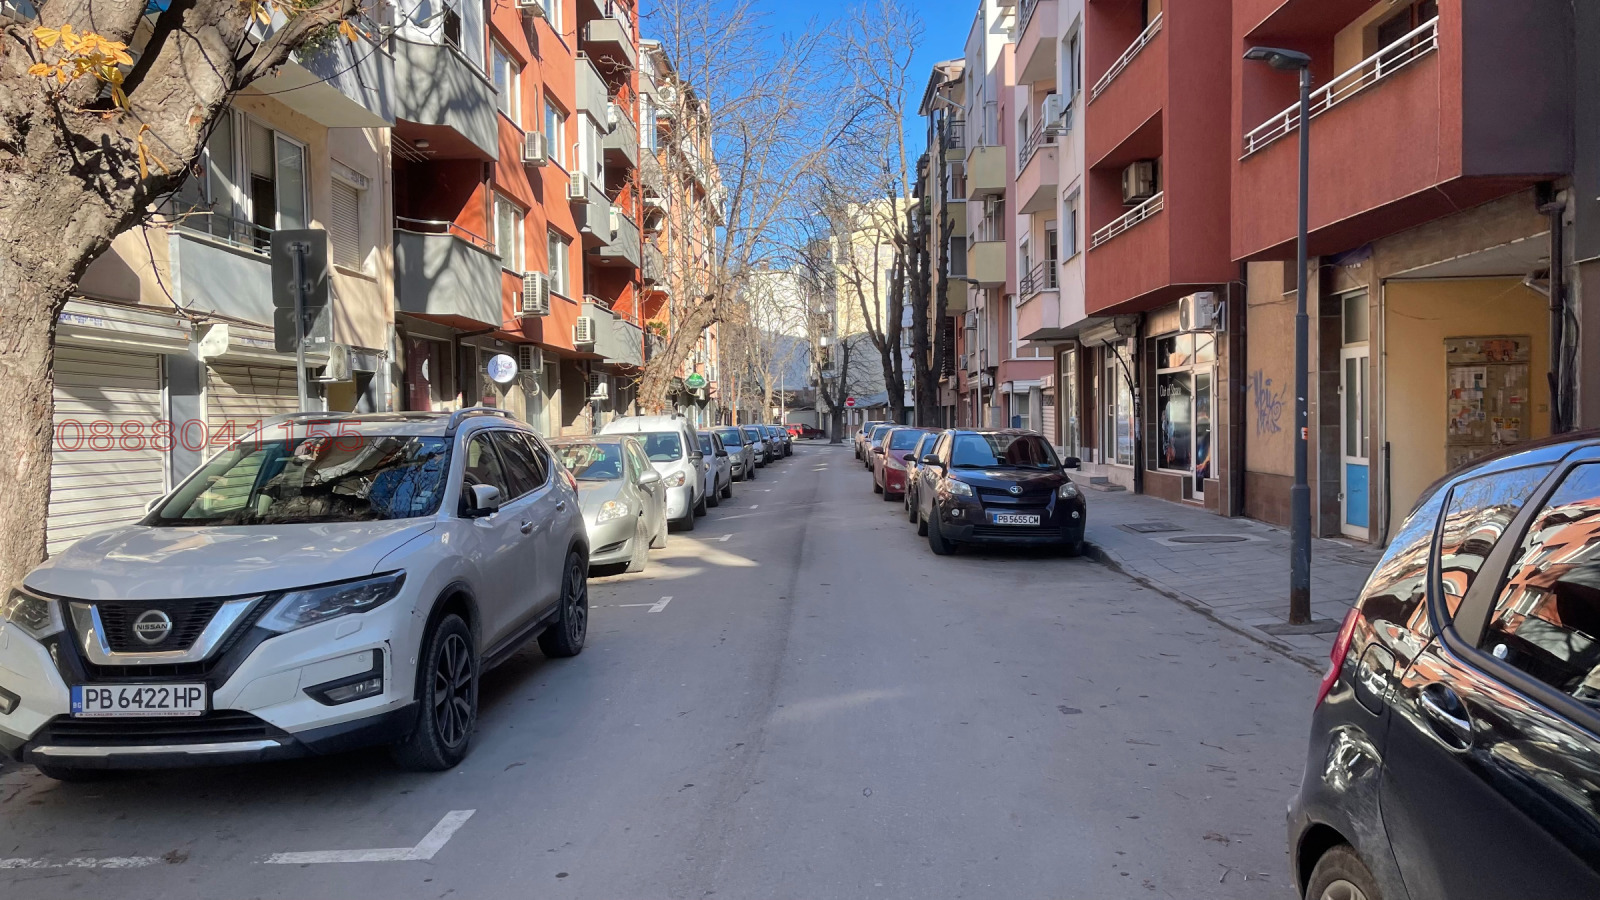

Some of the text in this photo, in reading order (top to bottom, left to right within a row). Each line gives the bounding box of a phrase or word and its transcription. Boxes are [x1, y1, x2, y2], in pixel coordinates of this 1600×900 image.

[998, 515, 1039, 524] PB 5655 CM
[85, 687, 202, 709] PB 6422 HP
